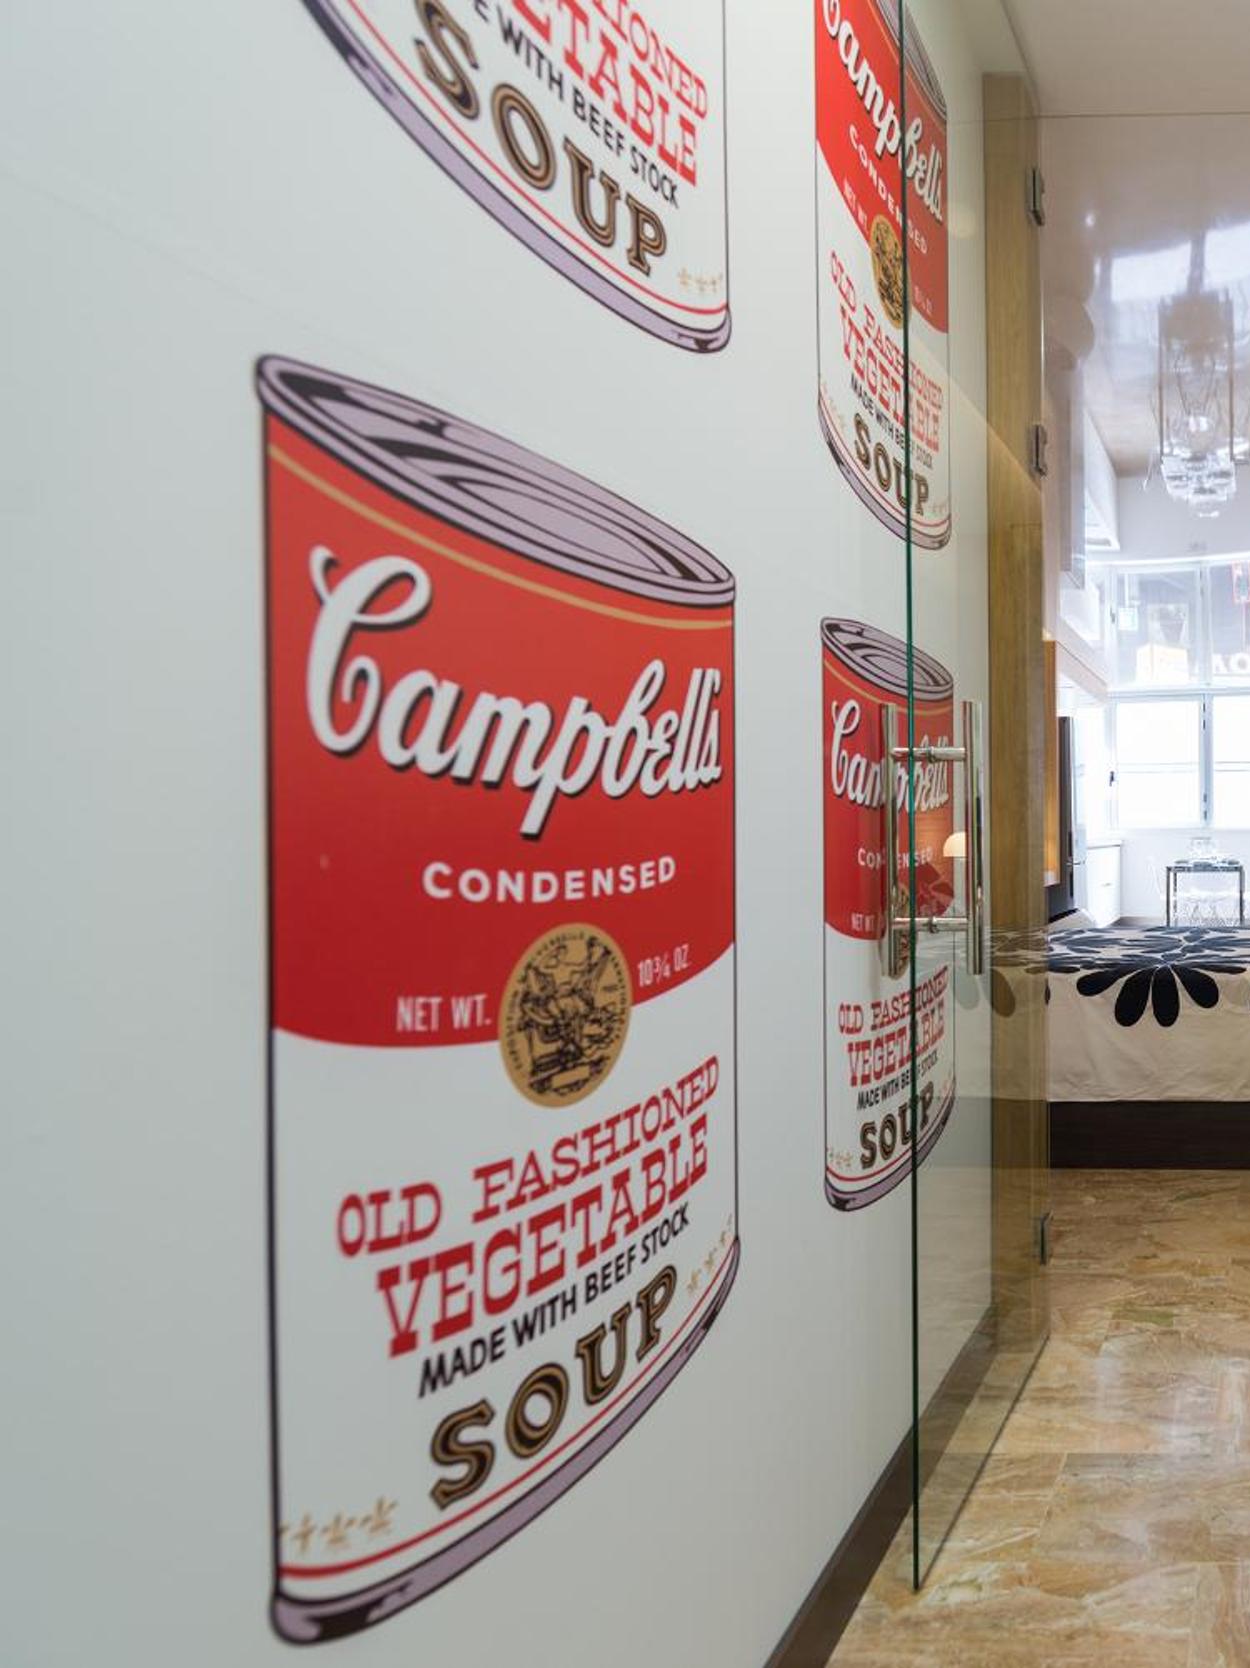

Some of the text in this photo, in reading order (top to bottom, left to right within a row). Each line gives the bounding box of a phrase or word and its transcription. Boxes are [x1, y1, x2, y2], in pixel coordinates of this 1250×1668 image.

[413, 0, 667, 277] SOUP
[497, 6, 678, 209] WITH BEEF STOCK
[592, 0, 706, 119] IONED
[840, 304, 939, 452] VEGETBLE
[307, 545, 722, 839] Campbell's
[422, 856, 676, 903] CONDENSED
[397, 996, 440, 1032] NET
[450, 994, 491, 1030] WT.
[338, 1055, 719, 1257] OLD FASHIONED
[376, 1113, 708, 1358] VEGETABLE
[418, 1201, 690, 1398] MADE WITH BEEF STOCK
[430, 1263, 677, 1511] SOUP
